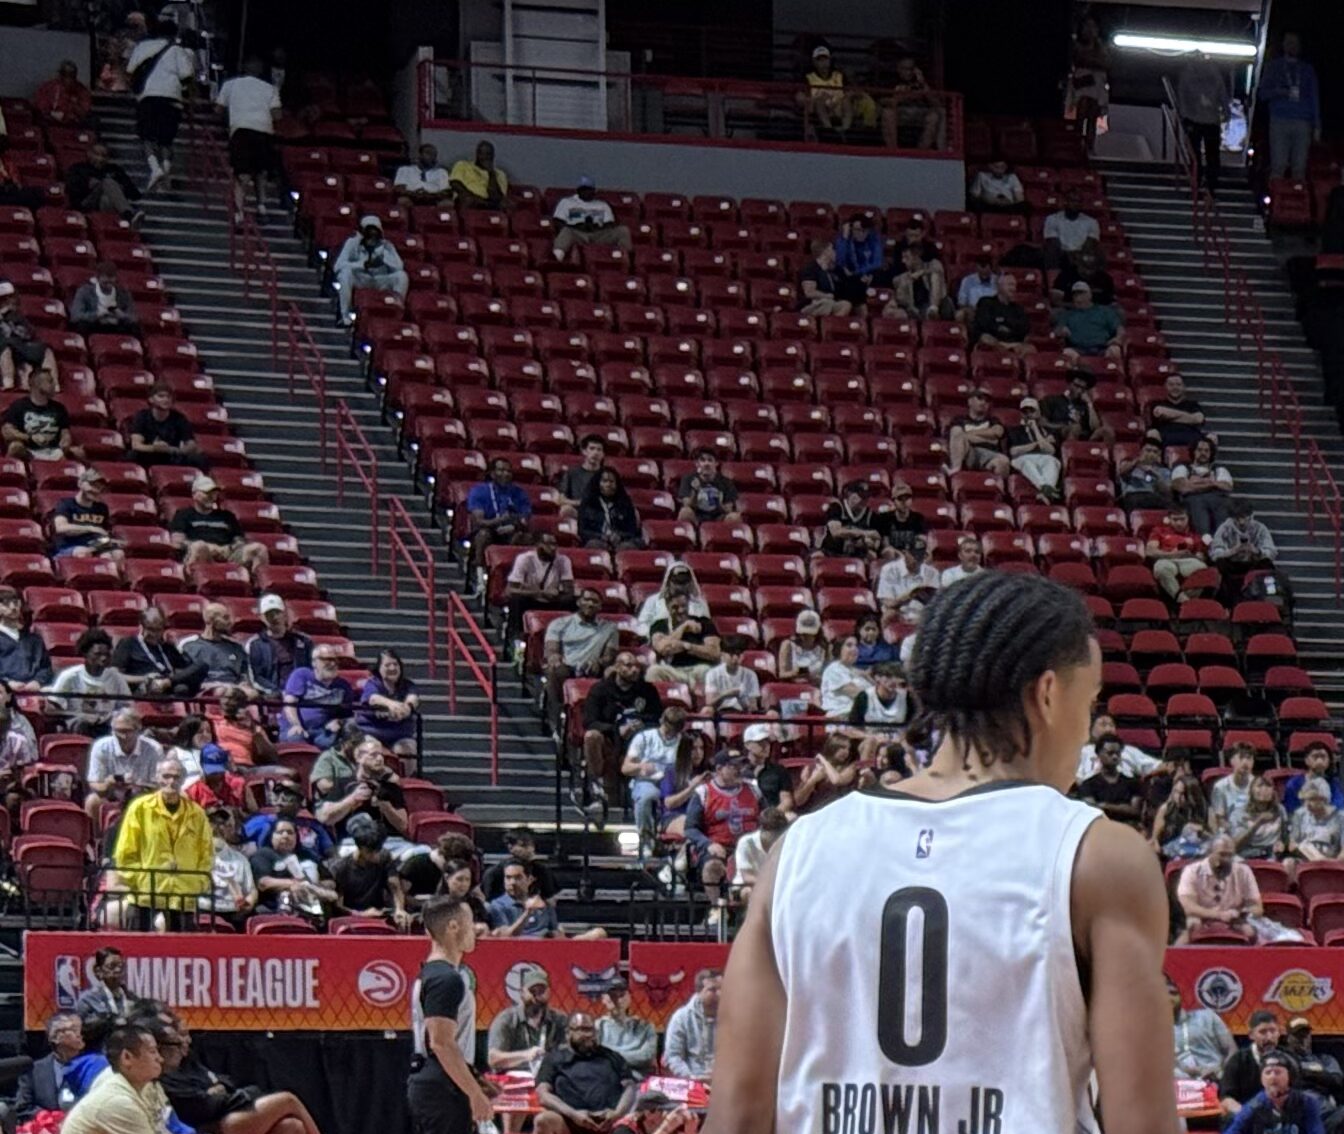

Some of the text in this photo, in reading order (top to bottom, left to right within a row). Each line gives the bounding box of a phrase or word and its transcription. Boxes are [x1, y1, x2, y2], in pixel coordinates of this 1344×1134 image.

[85, 956, 320, 1008] SMMER LEAGUE
[877, 886, 949, 1067] 0
